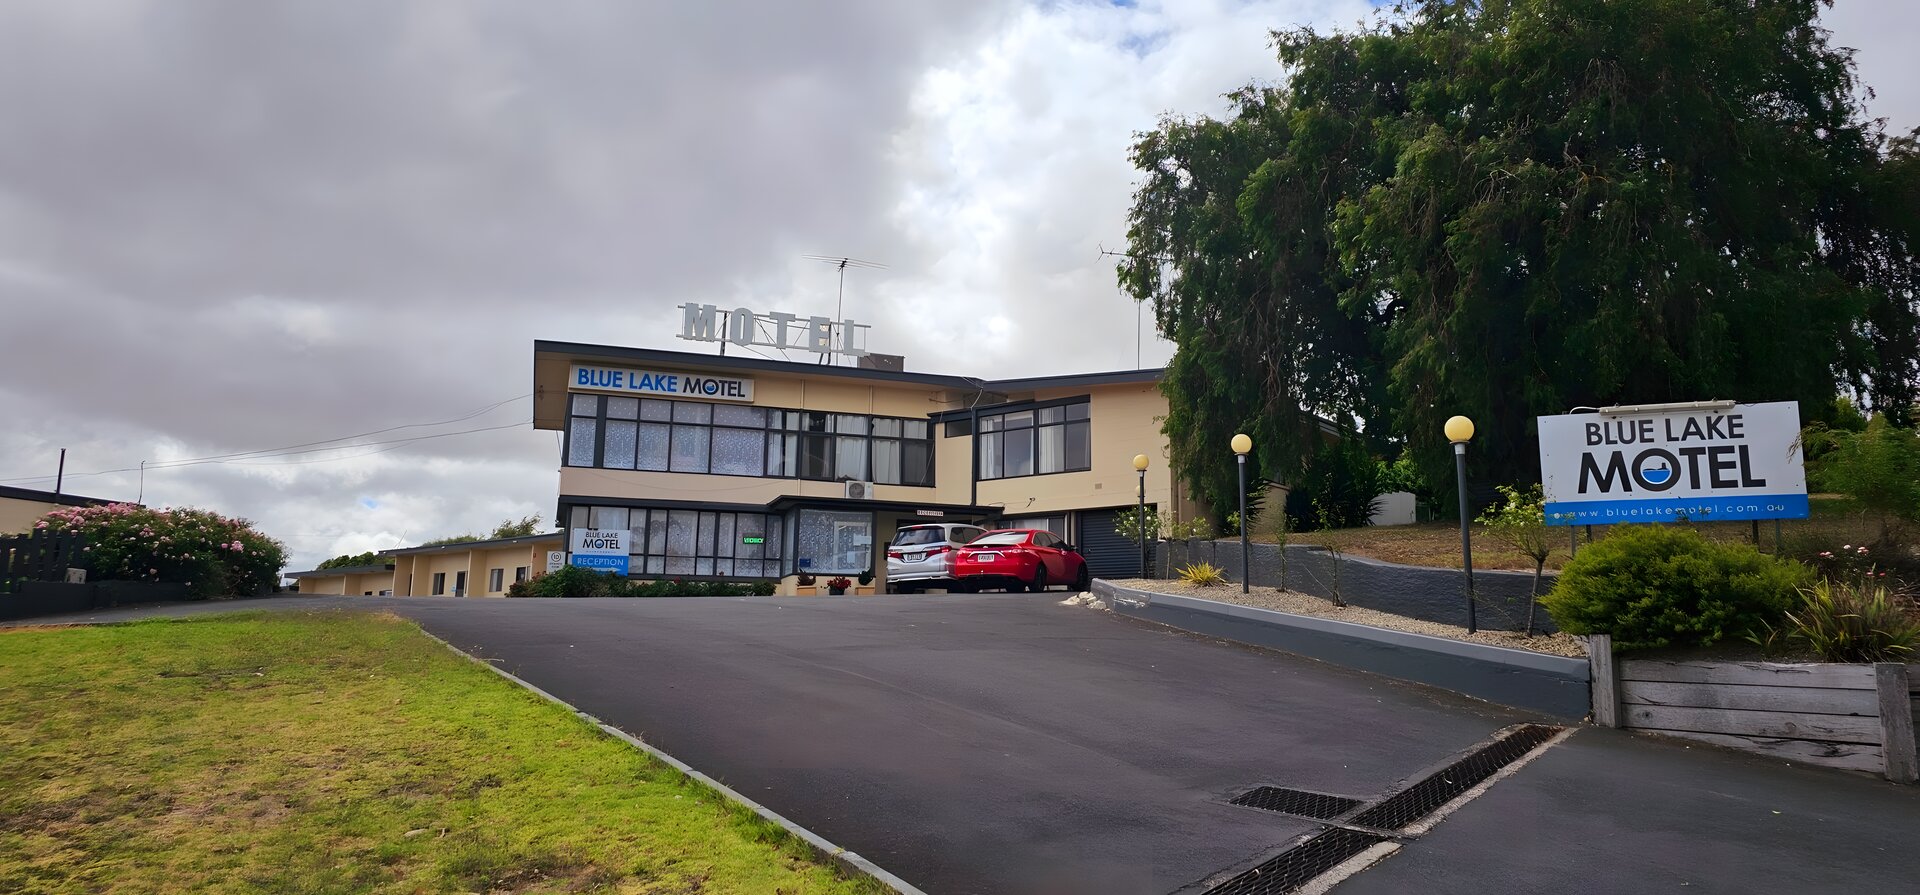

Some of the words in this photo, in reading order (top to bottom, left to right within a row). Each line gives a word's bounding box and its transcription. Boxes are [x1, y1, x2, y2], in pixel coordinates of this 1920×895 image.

[683, 302, 870, 357] MOTEL
[577, 368, 623, 389] BLUE
[629, 372, 678, 392] LAKE
[683, 377, 746, 398] MOTEL
[1585, 419, 1655, 446] BLUE
[1664, 414, 1745, 442] LAKE
[1577, 444, 1767, 494] MOTEL
[582, 538, 621, 549] MOTEL
[585, 531, 601, 539] BLUE
[577, 557, 624, 566] RECEPTION
